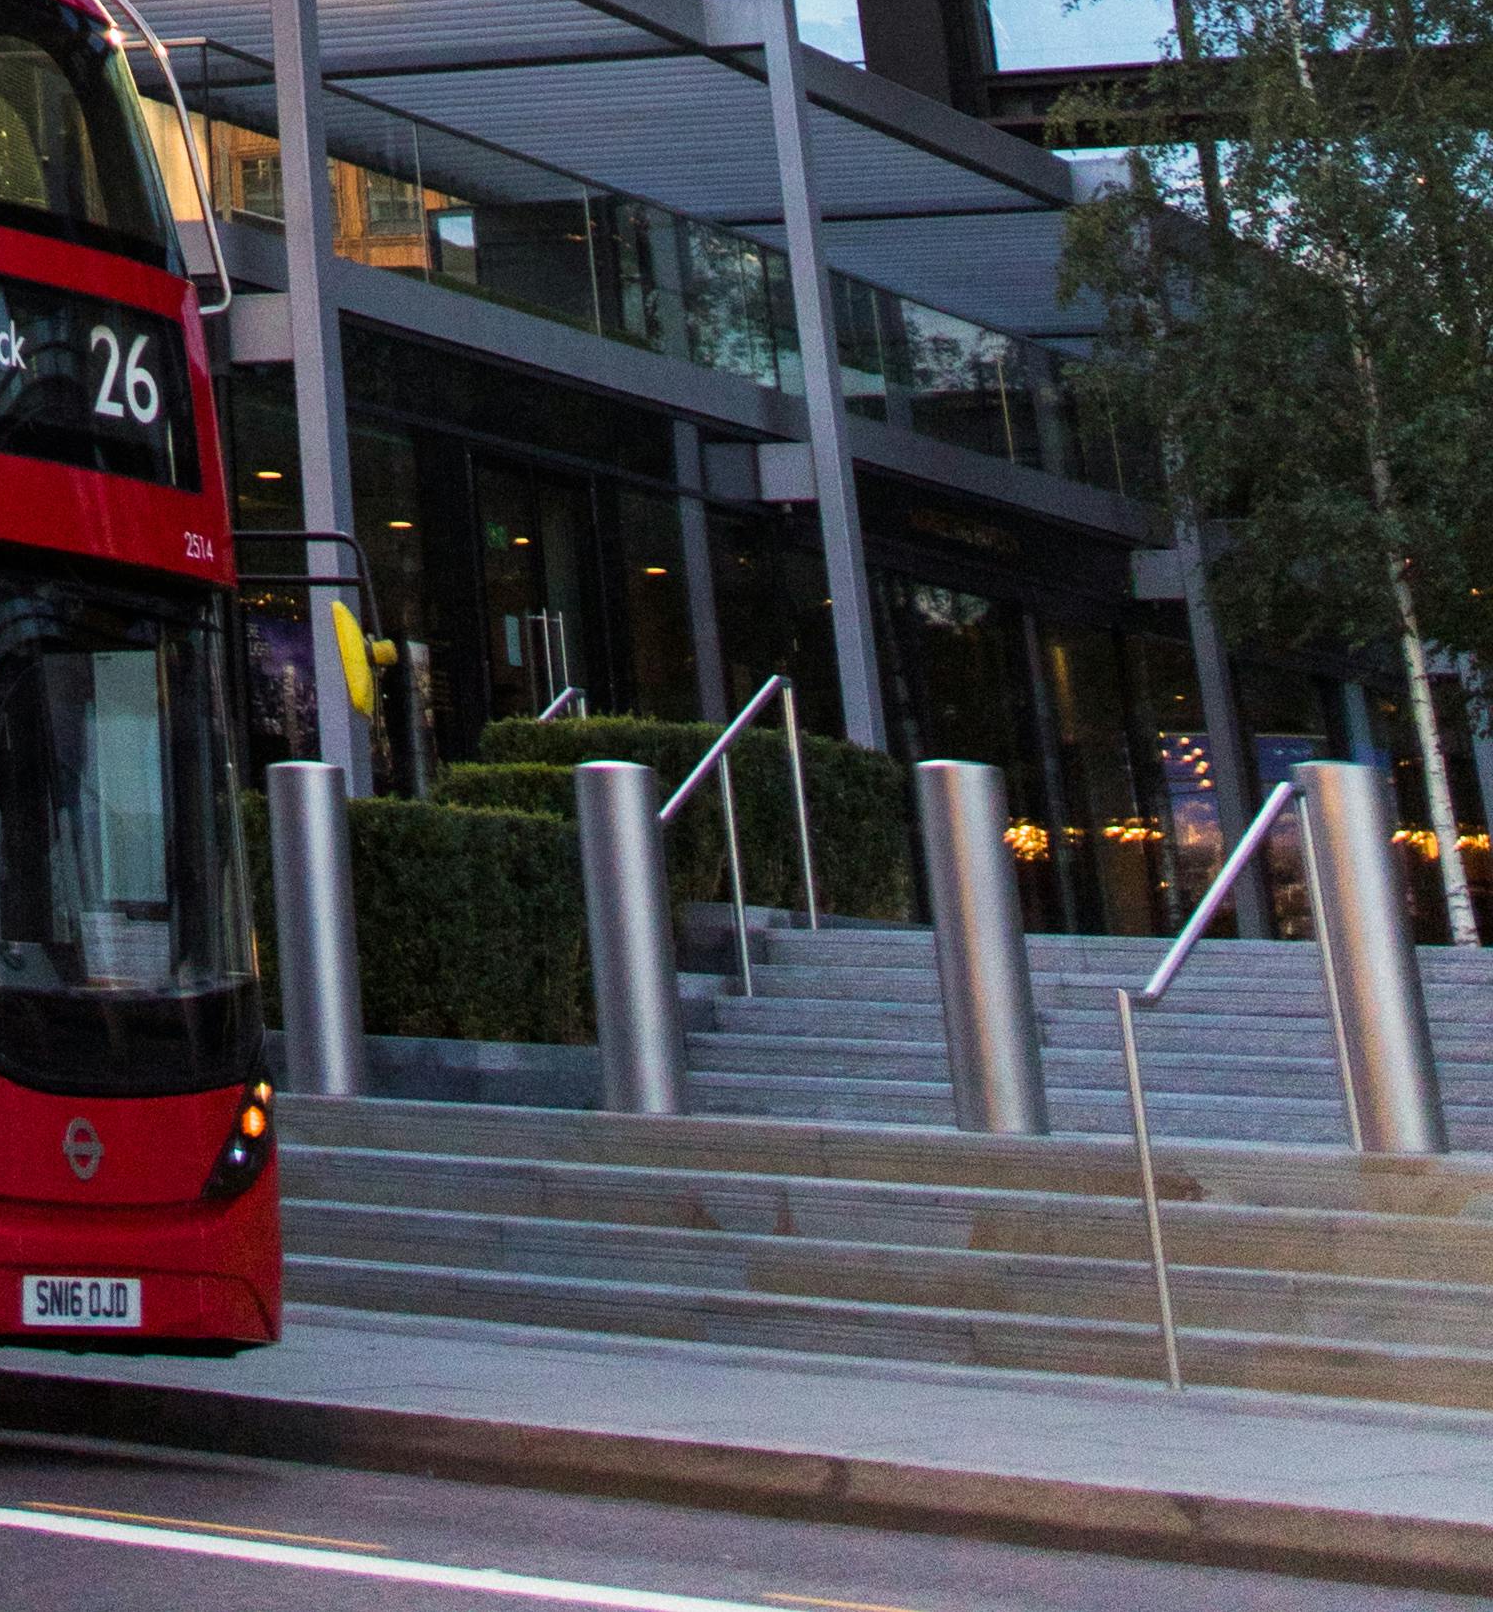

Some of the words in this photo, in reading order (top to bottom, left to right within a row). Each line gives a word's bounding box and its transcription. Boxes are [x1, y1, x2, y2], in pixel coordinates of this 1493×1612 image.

[90, 324, 160, 424] 26
[184, 531, 214, 562] 2514
[36, 1280, 83, 1317] SN16
[88, 1281, 128, 1318] OJD
